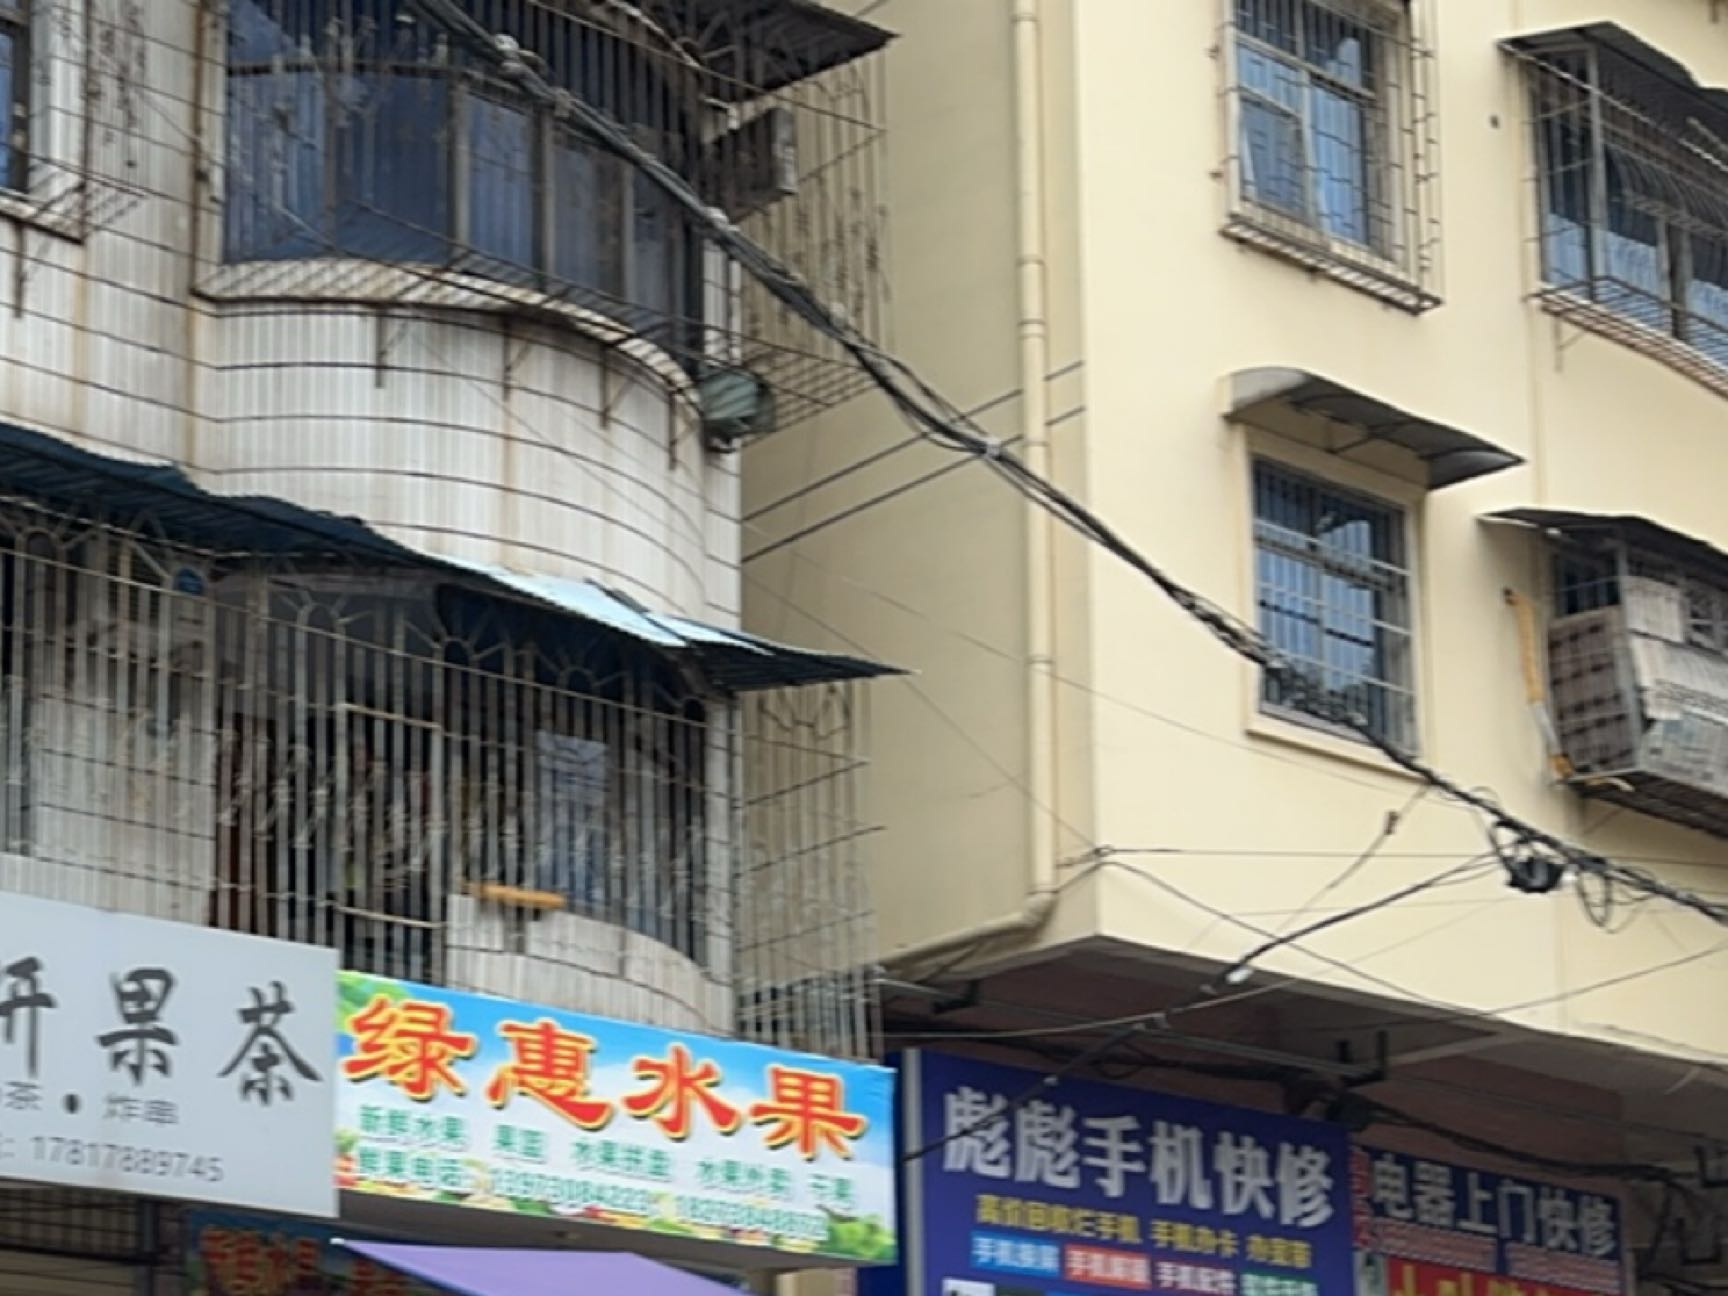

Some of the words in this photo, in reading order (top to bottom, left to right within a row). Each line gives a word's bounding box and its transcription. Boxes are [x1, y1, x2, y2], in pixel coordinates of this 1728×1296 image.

[340, 994, 866, 1161] 绿惠水果
[942, 1086, 1335, 1229] 彪彪手机快修
[1373, 1152, 1615, 1256] 电器上门快修
